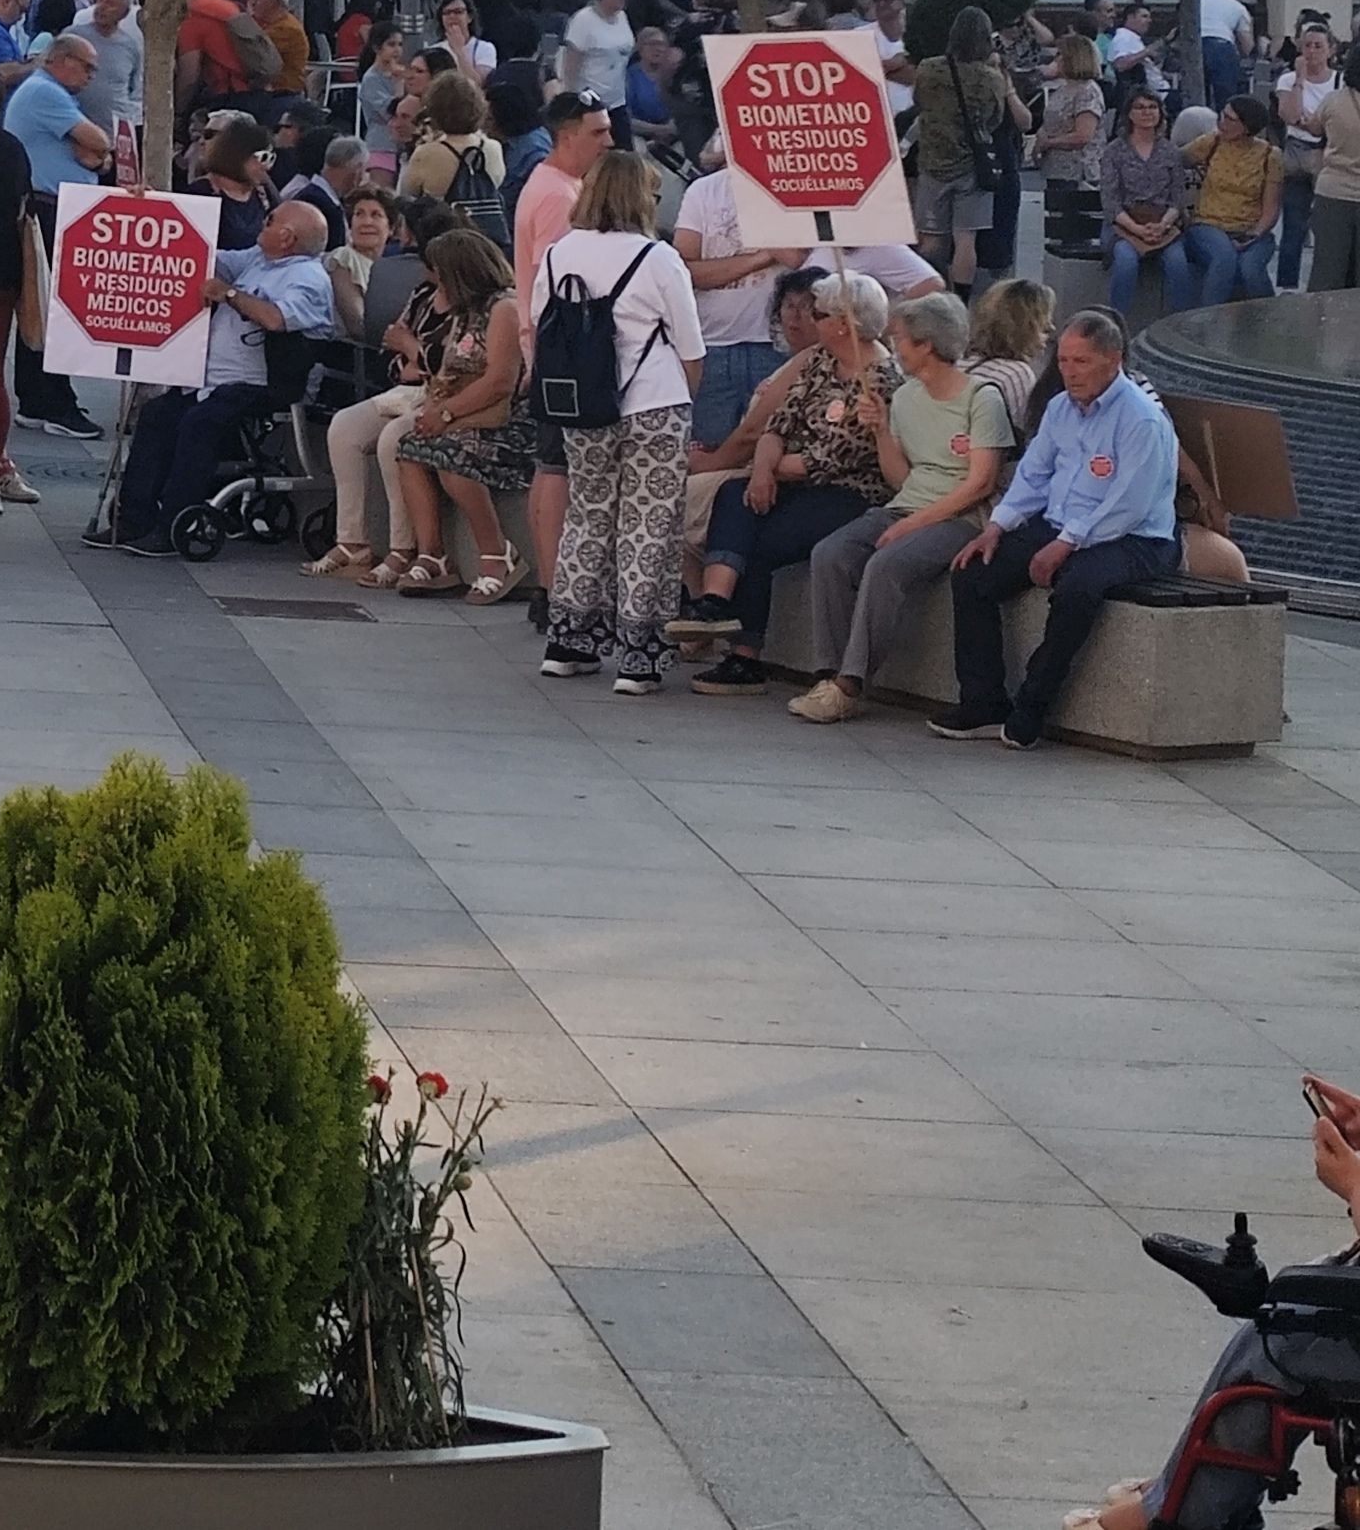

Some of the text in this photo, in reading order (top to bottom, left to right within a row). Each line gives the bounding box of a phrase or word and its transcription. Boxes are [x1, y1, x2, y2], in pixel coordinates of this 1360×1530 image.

[747, 62, 846, 99] STOP
[738, 101, 871, 127] BIOMETANO
[751, 128, 868, 150] Y RESIDUOS
[766, 150, 858, 173] MÉDICOS
[770, 175, 865, 192] SOCUÉLLAMOS
[90, 212, 184, 249] STOP
[73, 247, 196, 278] BIOMETANO
[79, 272, 186, 298] Y RESIDUOS
[87, 289, 172, 318] MÉDICOS
[85, 314, 172, 335] SOCUÉLLAMOS
